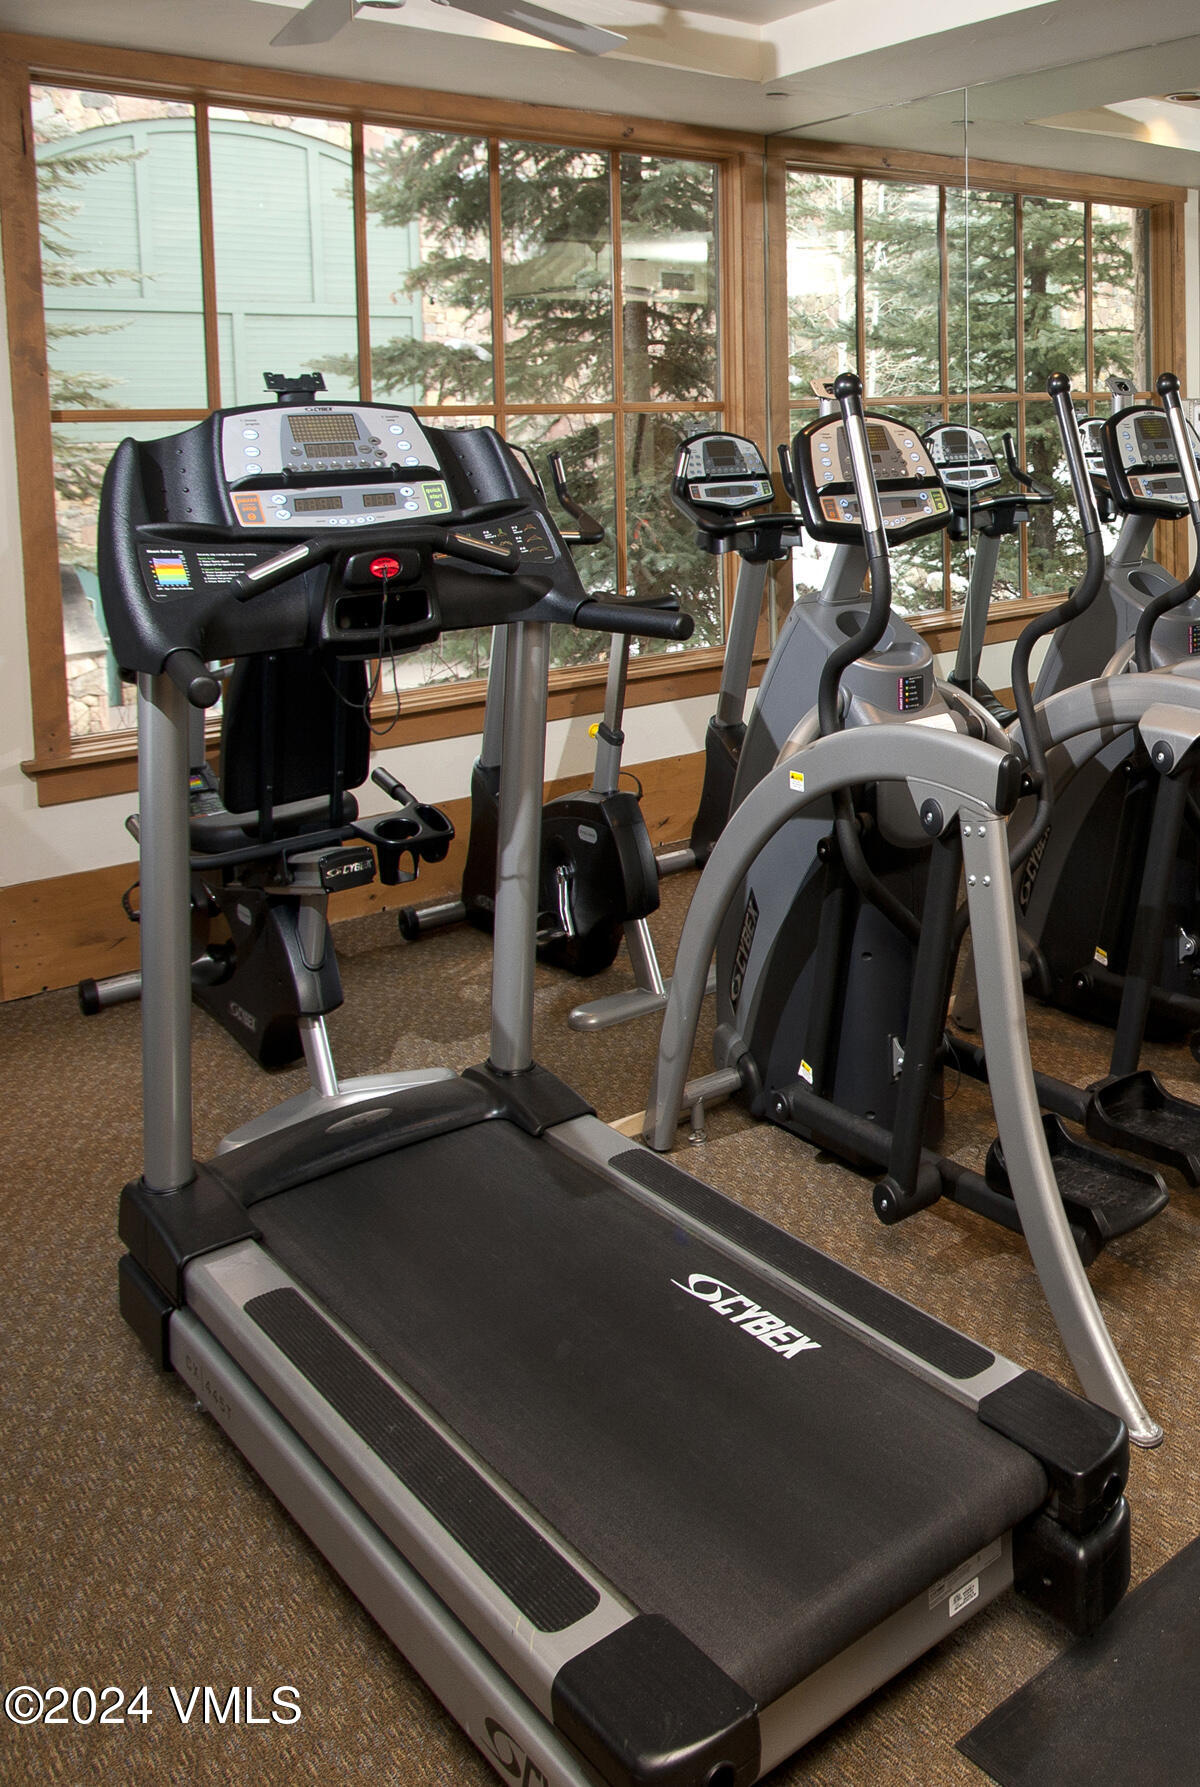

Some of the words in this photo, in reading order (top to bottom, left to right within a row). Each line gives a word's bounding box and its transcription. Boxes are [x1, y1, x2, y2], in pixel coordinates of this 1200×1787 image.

[342, 859, 373, 875] CYBEX
[737, 898, 758, 976] CYBEX
[709, 1295, 822, 1360] CYBEX
